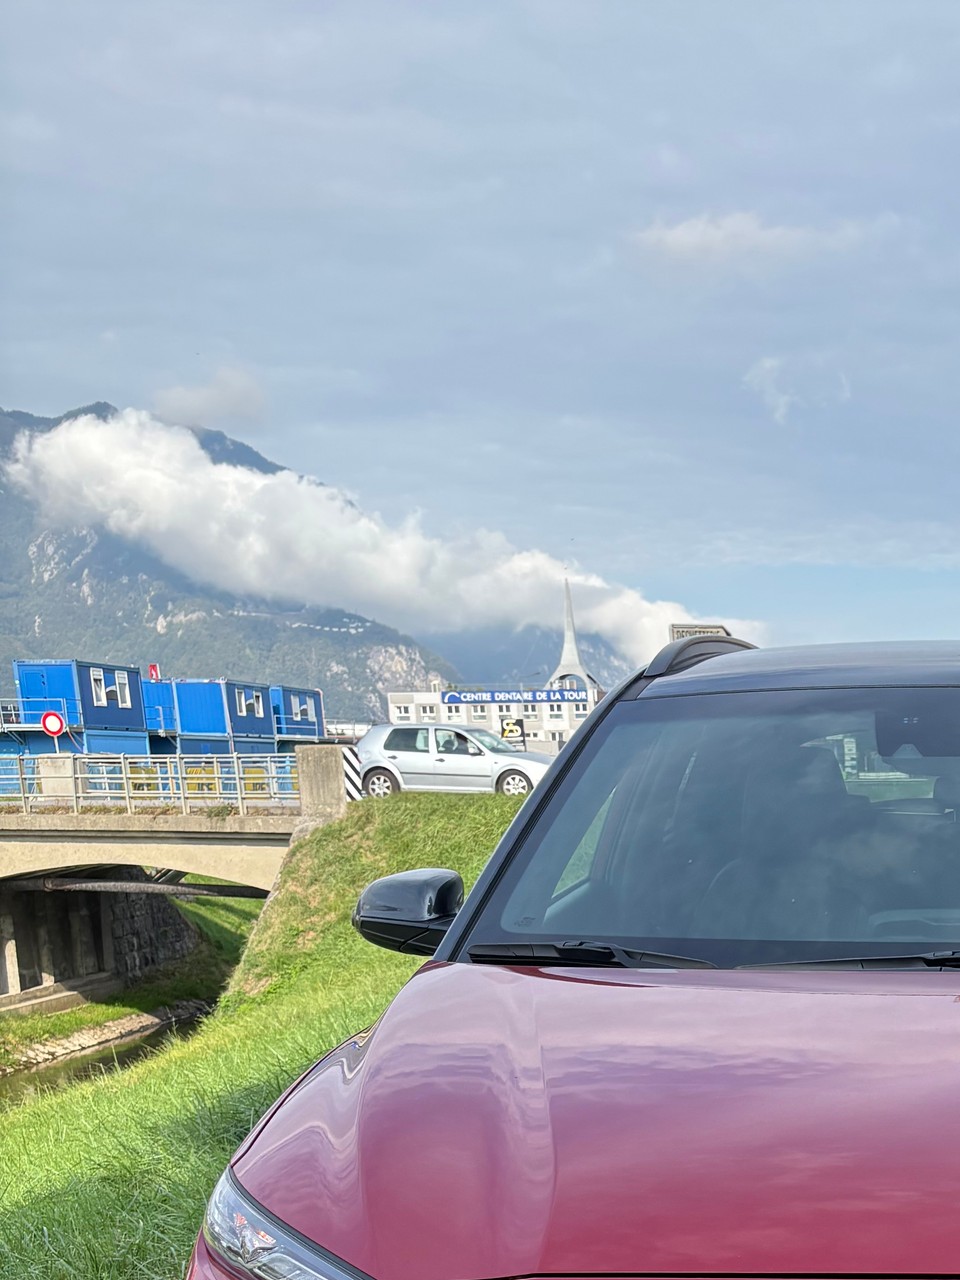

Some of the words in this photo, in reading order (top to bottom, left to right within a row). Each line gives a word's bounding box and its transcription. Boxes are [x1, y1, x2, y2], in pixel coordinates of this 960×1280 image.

[460, 692, 492, 701] CENTRE
[536, 691, 548, 700] DE
[550, 691, 561, 700] LA
[563, 691, 587, 700] TOUR
